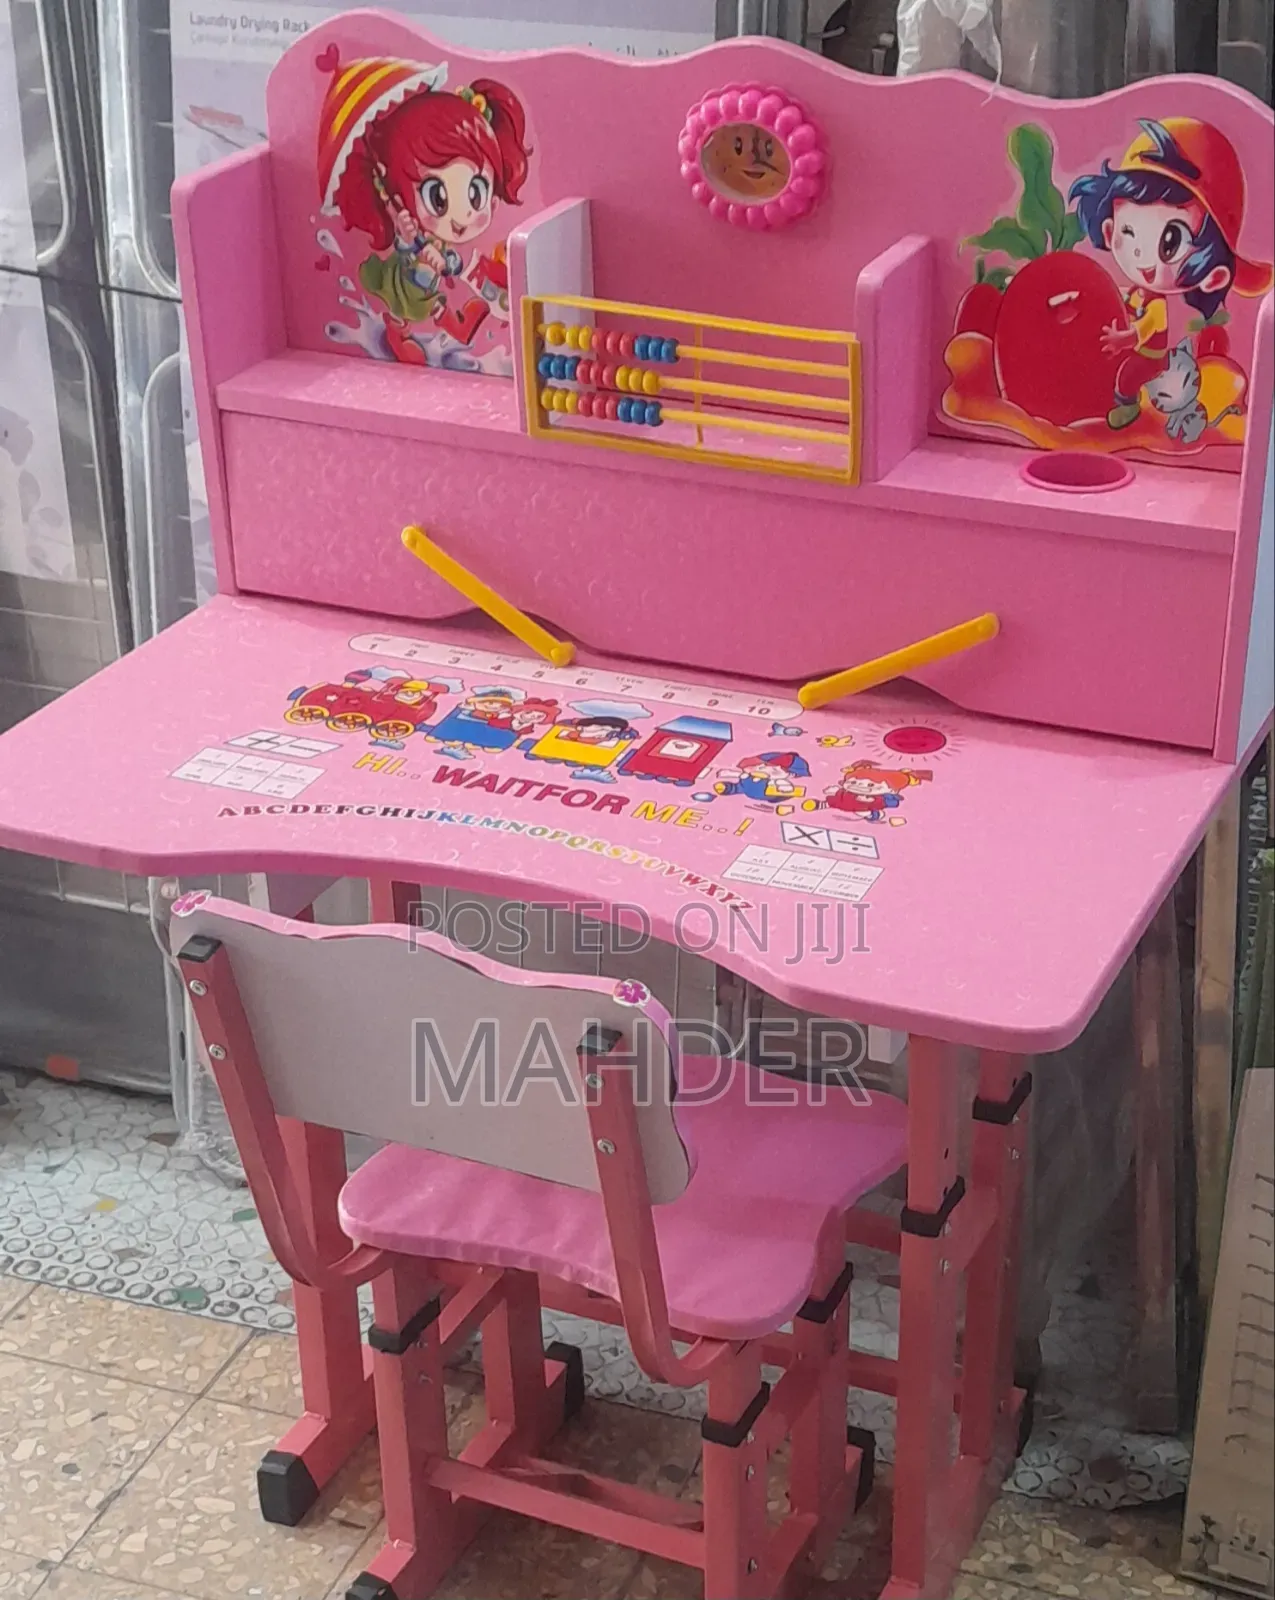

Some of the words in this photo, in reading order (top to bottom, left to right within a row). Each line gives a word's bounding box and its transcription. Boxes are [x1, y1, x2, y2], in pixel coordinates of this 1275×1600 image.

[189, 11, 237, 30] Laundry
[240, 15, 280, 34] Drying
[403, 648, 418, 657] 2
[447, 656, 462, 665] 3
[490, 664, 503, 672] 4
[531, 670, 545, 679] 5
[575, 677, 589, 686] 6
[620, 684, 633, 692] 7
[707, 698, 720, 707] 9
[747, 705, 771, 715] 10
[430, 763, 631, 815] WAITFOR
